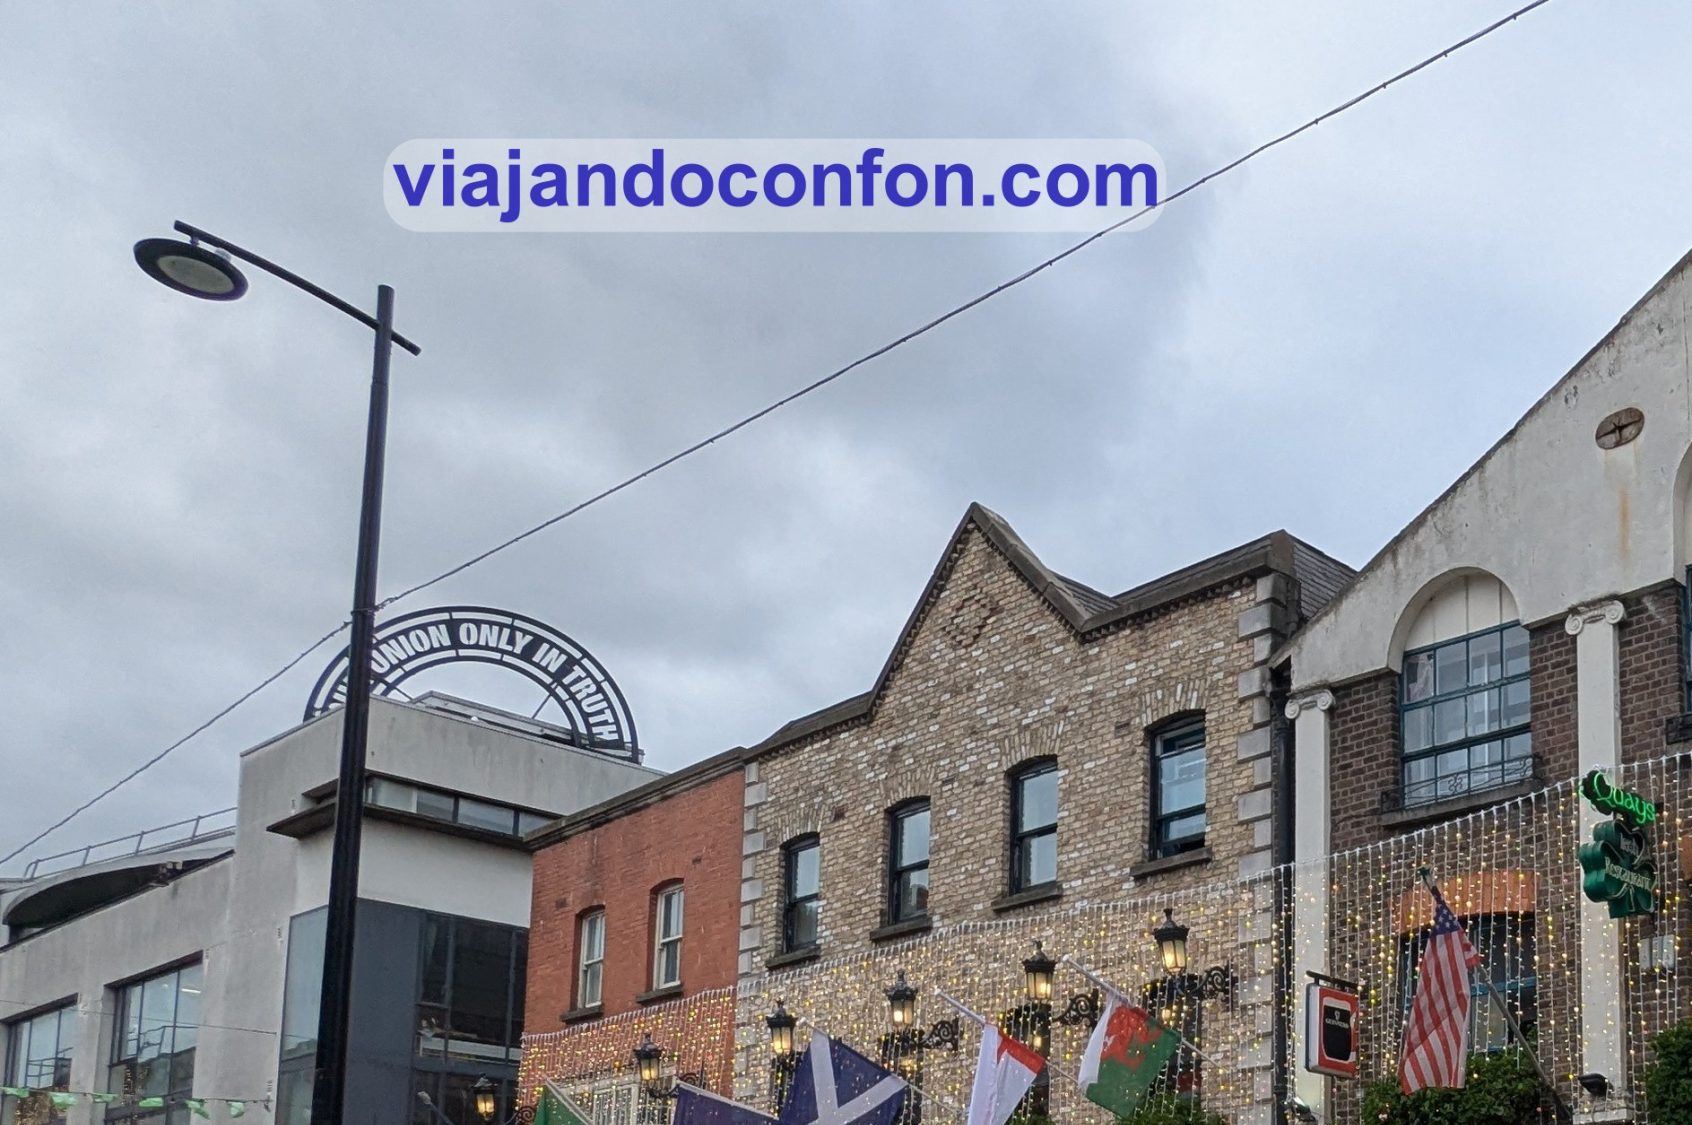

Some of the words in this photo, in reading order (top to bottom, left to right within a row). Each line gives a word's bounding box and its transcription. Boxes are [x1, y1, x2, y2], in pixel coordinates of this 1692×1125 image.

[371, 624, 450, 674] UNION
[459, 622, 533, 654] ONLY
[532, 643, 567, 671] IN
[562, 666, 618, 741] TRUTH
[1593, 771, 1655, 824] Quays
